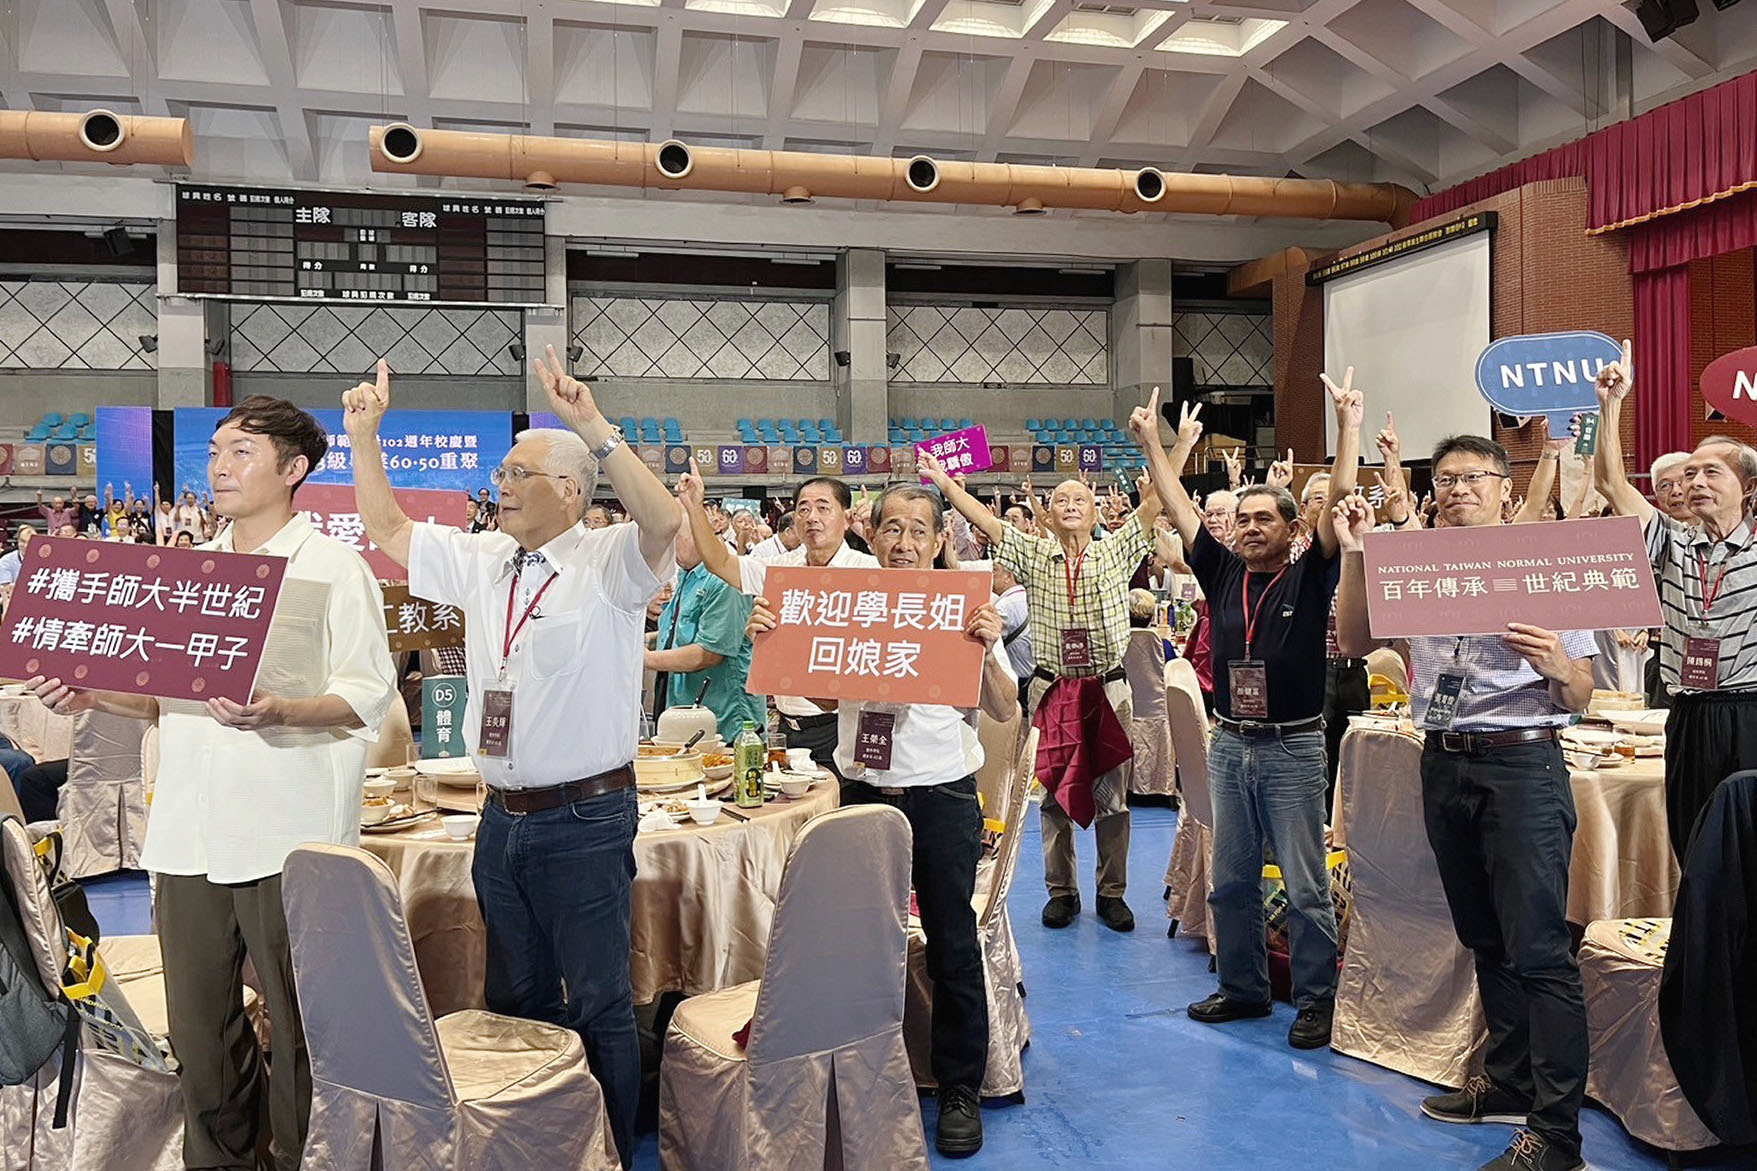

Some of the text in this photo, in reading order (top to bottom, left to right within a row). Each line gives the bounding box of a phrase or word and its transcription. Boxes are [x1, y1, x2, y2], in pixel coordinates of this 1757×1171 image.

[295, 206, 331, 224] 主隊
[401, 211, 437, 228] 客隊
[1500, 358, 1600, 389] NTNU
[930, 436, 970, 458] 我師大
[1378, 552, 1635, 575] NATIONAL TAIWAN NORMAL UNIVERSITY
[27, 567, 266, 620] #攜手師大半世紀
[1379, 567, 1641, 600] 百年傳承 世紀典範
[778, 588, 966, 632] 歡迎學長姐
[11, 615, 249, 671] #情牽師大一甲子
[807, 636, 922, 679] 回娘家
[435, 689, 453, 702] D5
[436, 709, 452, 743] 體育
